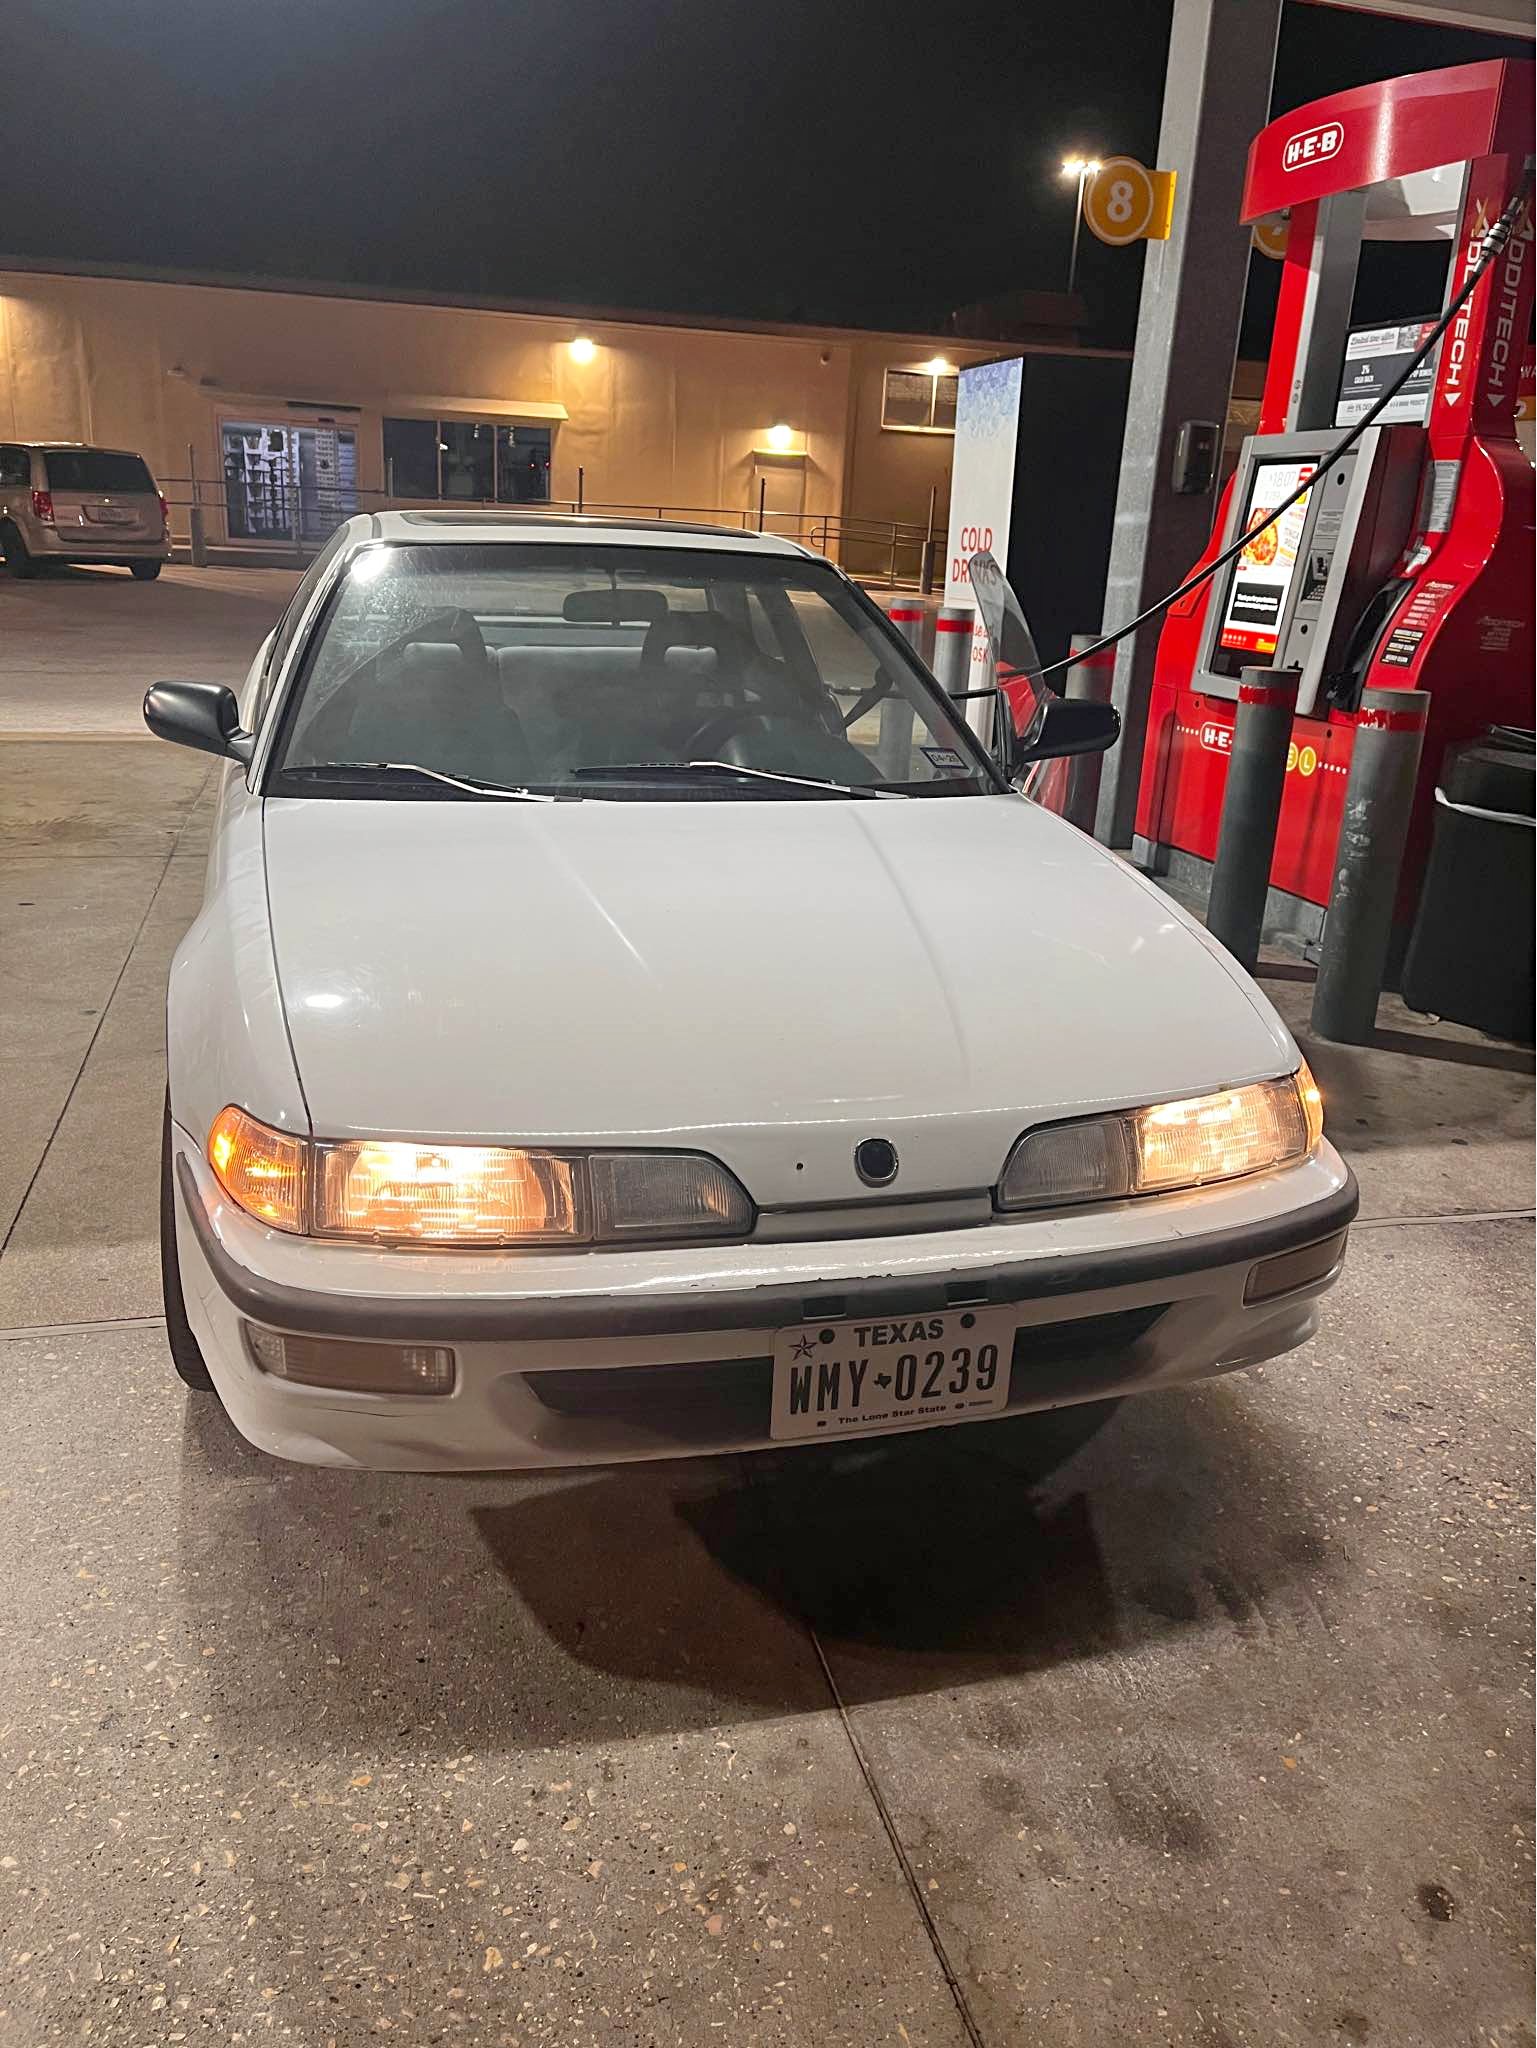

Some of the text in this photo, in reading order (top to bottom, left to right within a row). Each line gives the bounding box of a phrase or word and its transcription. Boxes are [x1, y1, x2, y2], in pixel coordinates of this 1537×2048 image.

[1107, 180, 1133, 222] 8
[961, 527, 992, 552] COLD
[854, 1318, 944, 1348] TEXAS
[789, 1344, 999, 1415] WMY 0239
[837, 1404, 947, 1425] The Lone Star State
